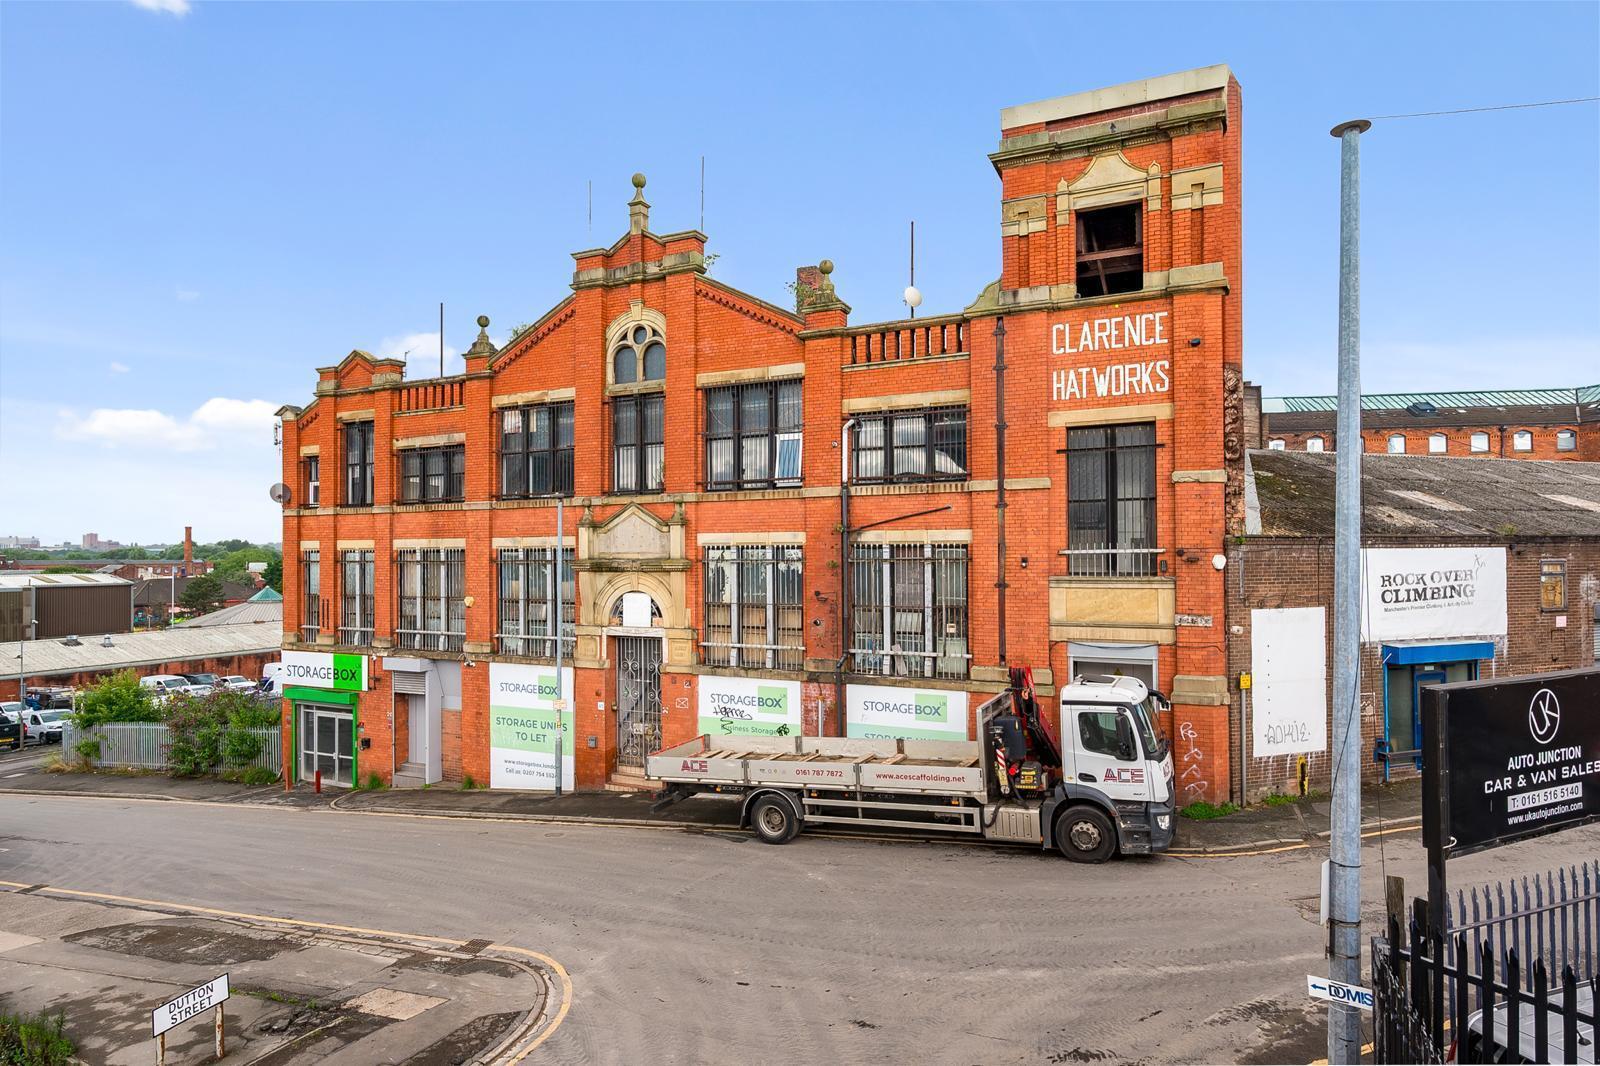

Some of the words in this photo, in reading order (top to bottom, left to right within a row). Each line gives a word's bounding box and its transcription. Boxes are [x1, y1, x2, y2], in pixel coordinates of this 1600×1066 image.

[1052, 311, 1168, 355] CLARENCE
[1052, 360, 1169, 400] HATWORKS
[1380, 573, 1427, 587] ROCK
[1430, 569, 1473, 584] OVER
[1381, 584, 1476, 604] CLIMBING
[286, 665, 357, 681] STORAGEBOX
[500, 682, 558, 695] STORAGEBOX
[710, 693, 782, 708] STORAGEBOX
[863, 700, 941, 716] STORAGEBOX
[496, 716, 538, 728] STORAGE
[540, 721, 568, 732] UNIS
[515, 732, 528, 741] TO
[530, 733, 547, 743] LET
[681, 760, 708, 773] ACE
[1507, 754, 1534, 771] AUTO
[1536, 745, 1581, 765] JUNCTION
[812, 769, 824, 777] 787
[875, 773, 965, 783] www.acescaffolding.net
[1103, 768, 1144, 783] ACE
[1484, 777, 1512, 794] CAR
[1517, 774, 1527, 788] &
[1530, 768, 1556, 784] VAN
[1561, 760, 1600, 779] SALES
[1511, 797, 1519, 809] T:
[1521, 794, 1541, 806] 0161
[1543, 789, 1558, 802] 516
[1560, 785, 1579, 797] 5140
[1507, 801, 1583, 825] www.ukautojunction.com
[168, 983, 214, 1014] DUTTON
[1328, 984, 1375, 1007] DOMIS
[171, 995, 213, 1025] STREET
